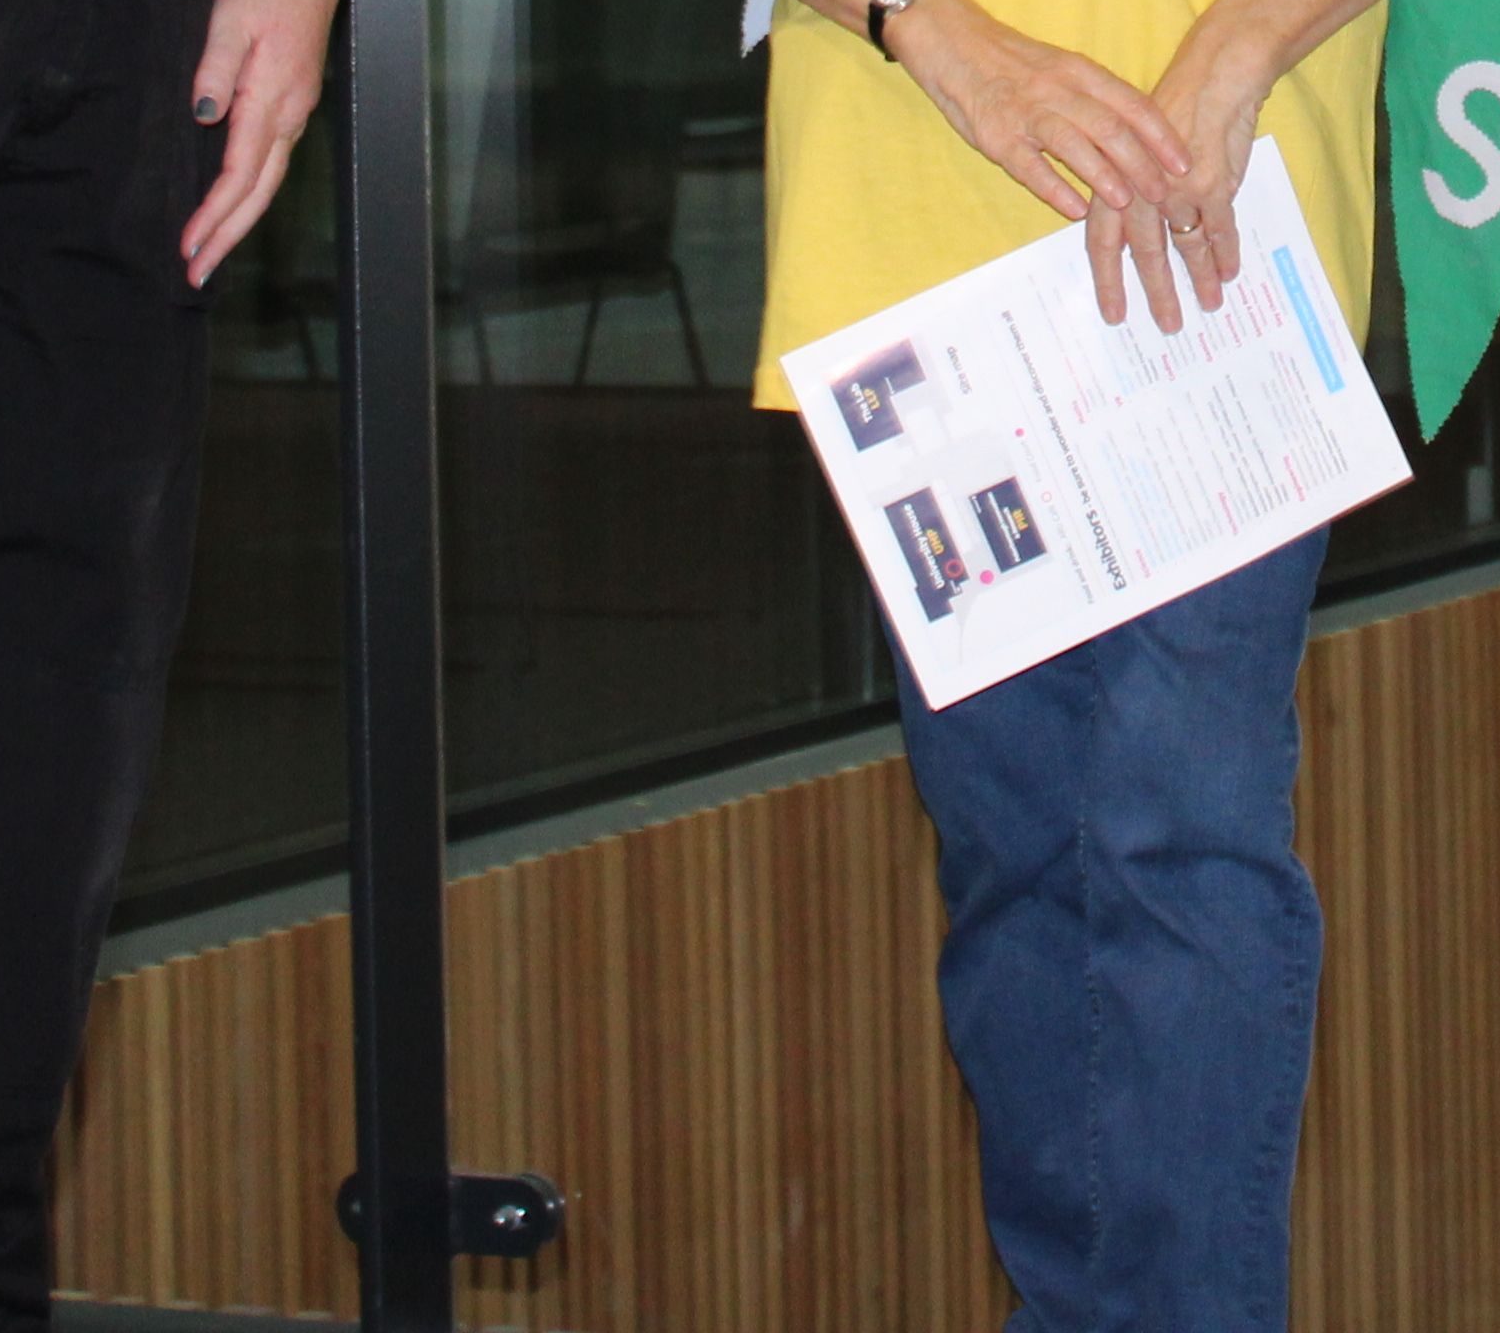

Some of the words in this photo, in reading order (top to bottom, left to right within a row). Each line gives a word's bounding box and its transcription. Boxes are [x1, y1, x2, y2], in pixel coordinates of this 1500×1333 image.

[1000, 309, 1014, 324] all
[1006, 322, 1026, 351] them
[945, 344, 965, 372] map
[955, 371, 973, 395] Site
[1018, 350, 1045, 395] discover
[848, 381, 865, 403] Lab
[857, 401, 874, 423] The
[1037, 394, 1053, 416] and
[1046, 415, 1070, 454] wonder
[1063, 453, 1075, 466] to
[1069, 465, 1085, 489] sure
[1077, 488, 1091, 504] be
[901, 502, 923, 537] House
[915, 534, 946, 589] University
[1081, 508, 1127, 591] Exhibitors
